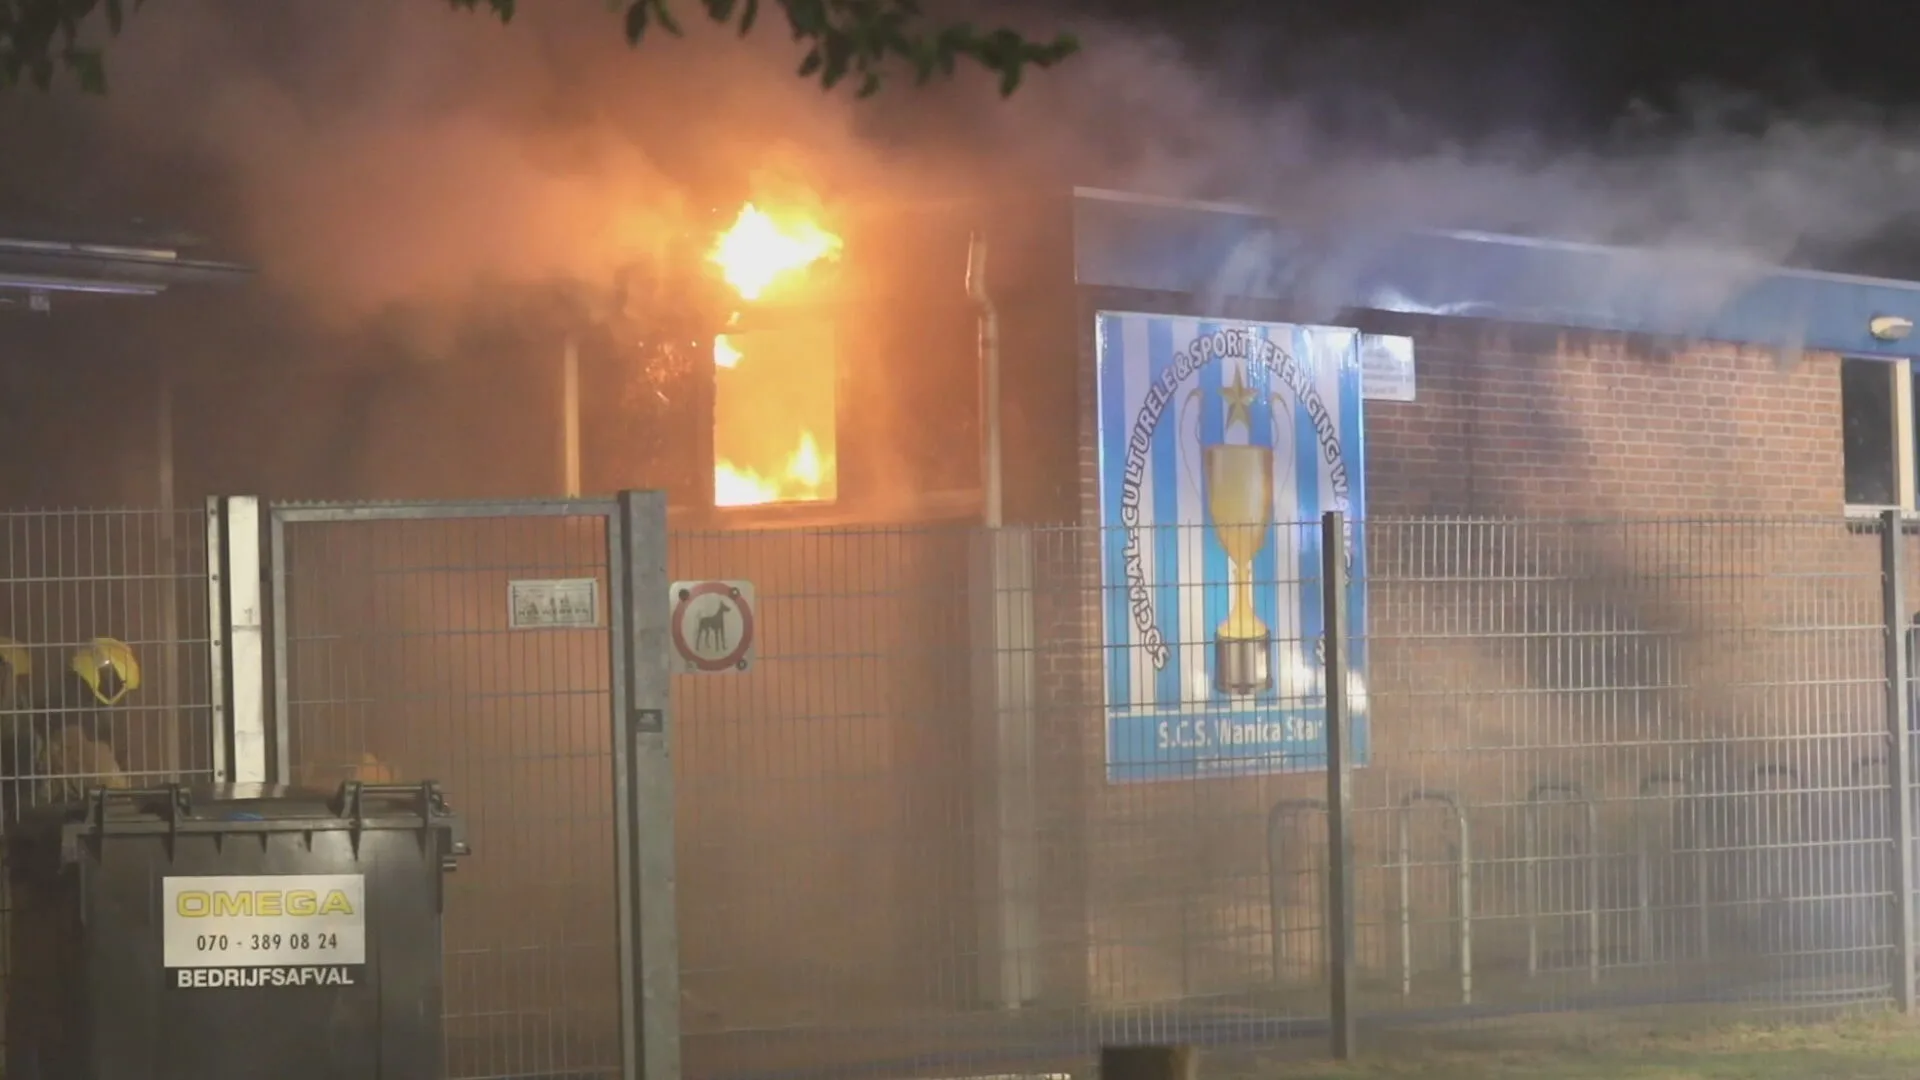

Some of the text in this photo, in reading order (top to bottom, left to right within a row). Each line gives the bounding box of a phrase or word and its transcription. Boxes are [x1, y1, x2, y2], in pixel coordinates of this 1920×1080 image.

[1174, 351, 1194, 381] &
[1189, 329, 1341, 465] SPORTVERENIGING
[1158, 714, 1323, 748] S.C.S. Wanica Star
[176, 889, 354, 917] OMEGA
[197, 935, 228, 951] 070
[251, 934, 281, 950] 389
[290, 933, 310, 950] 08
[318, 933, 338, 949] 24
[177, 967, 354, 988] BEDRIJFSAFVAL
